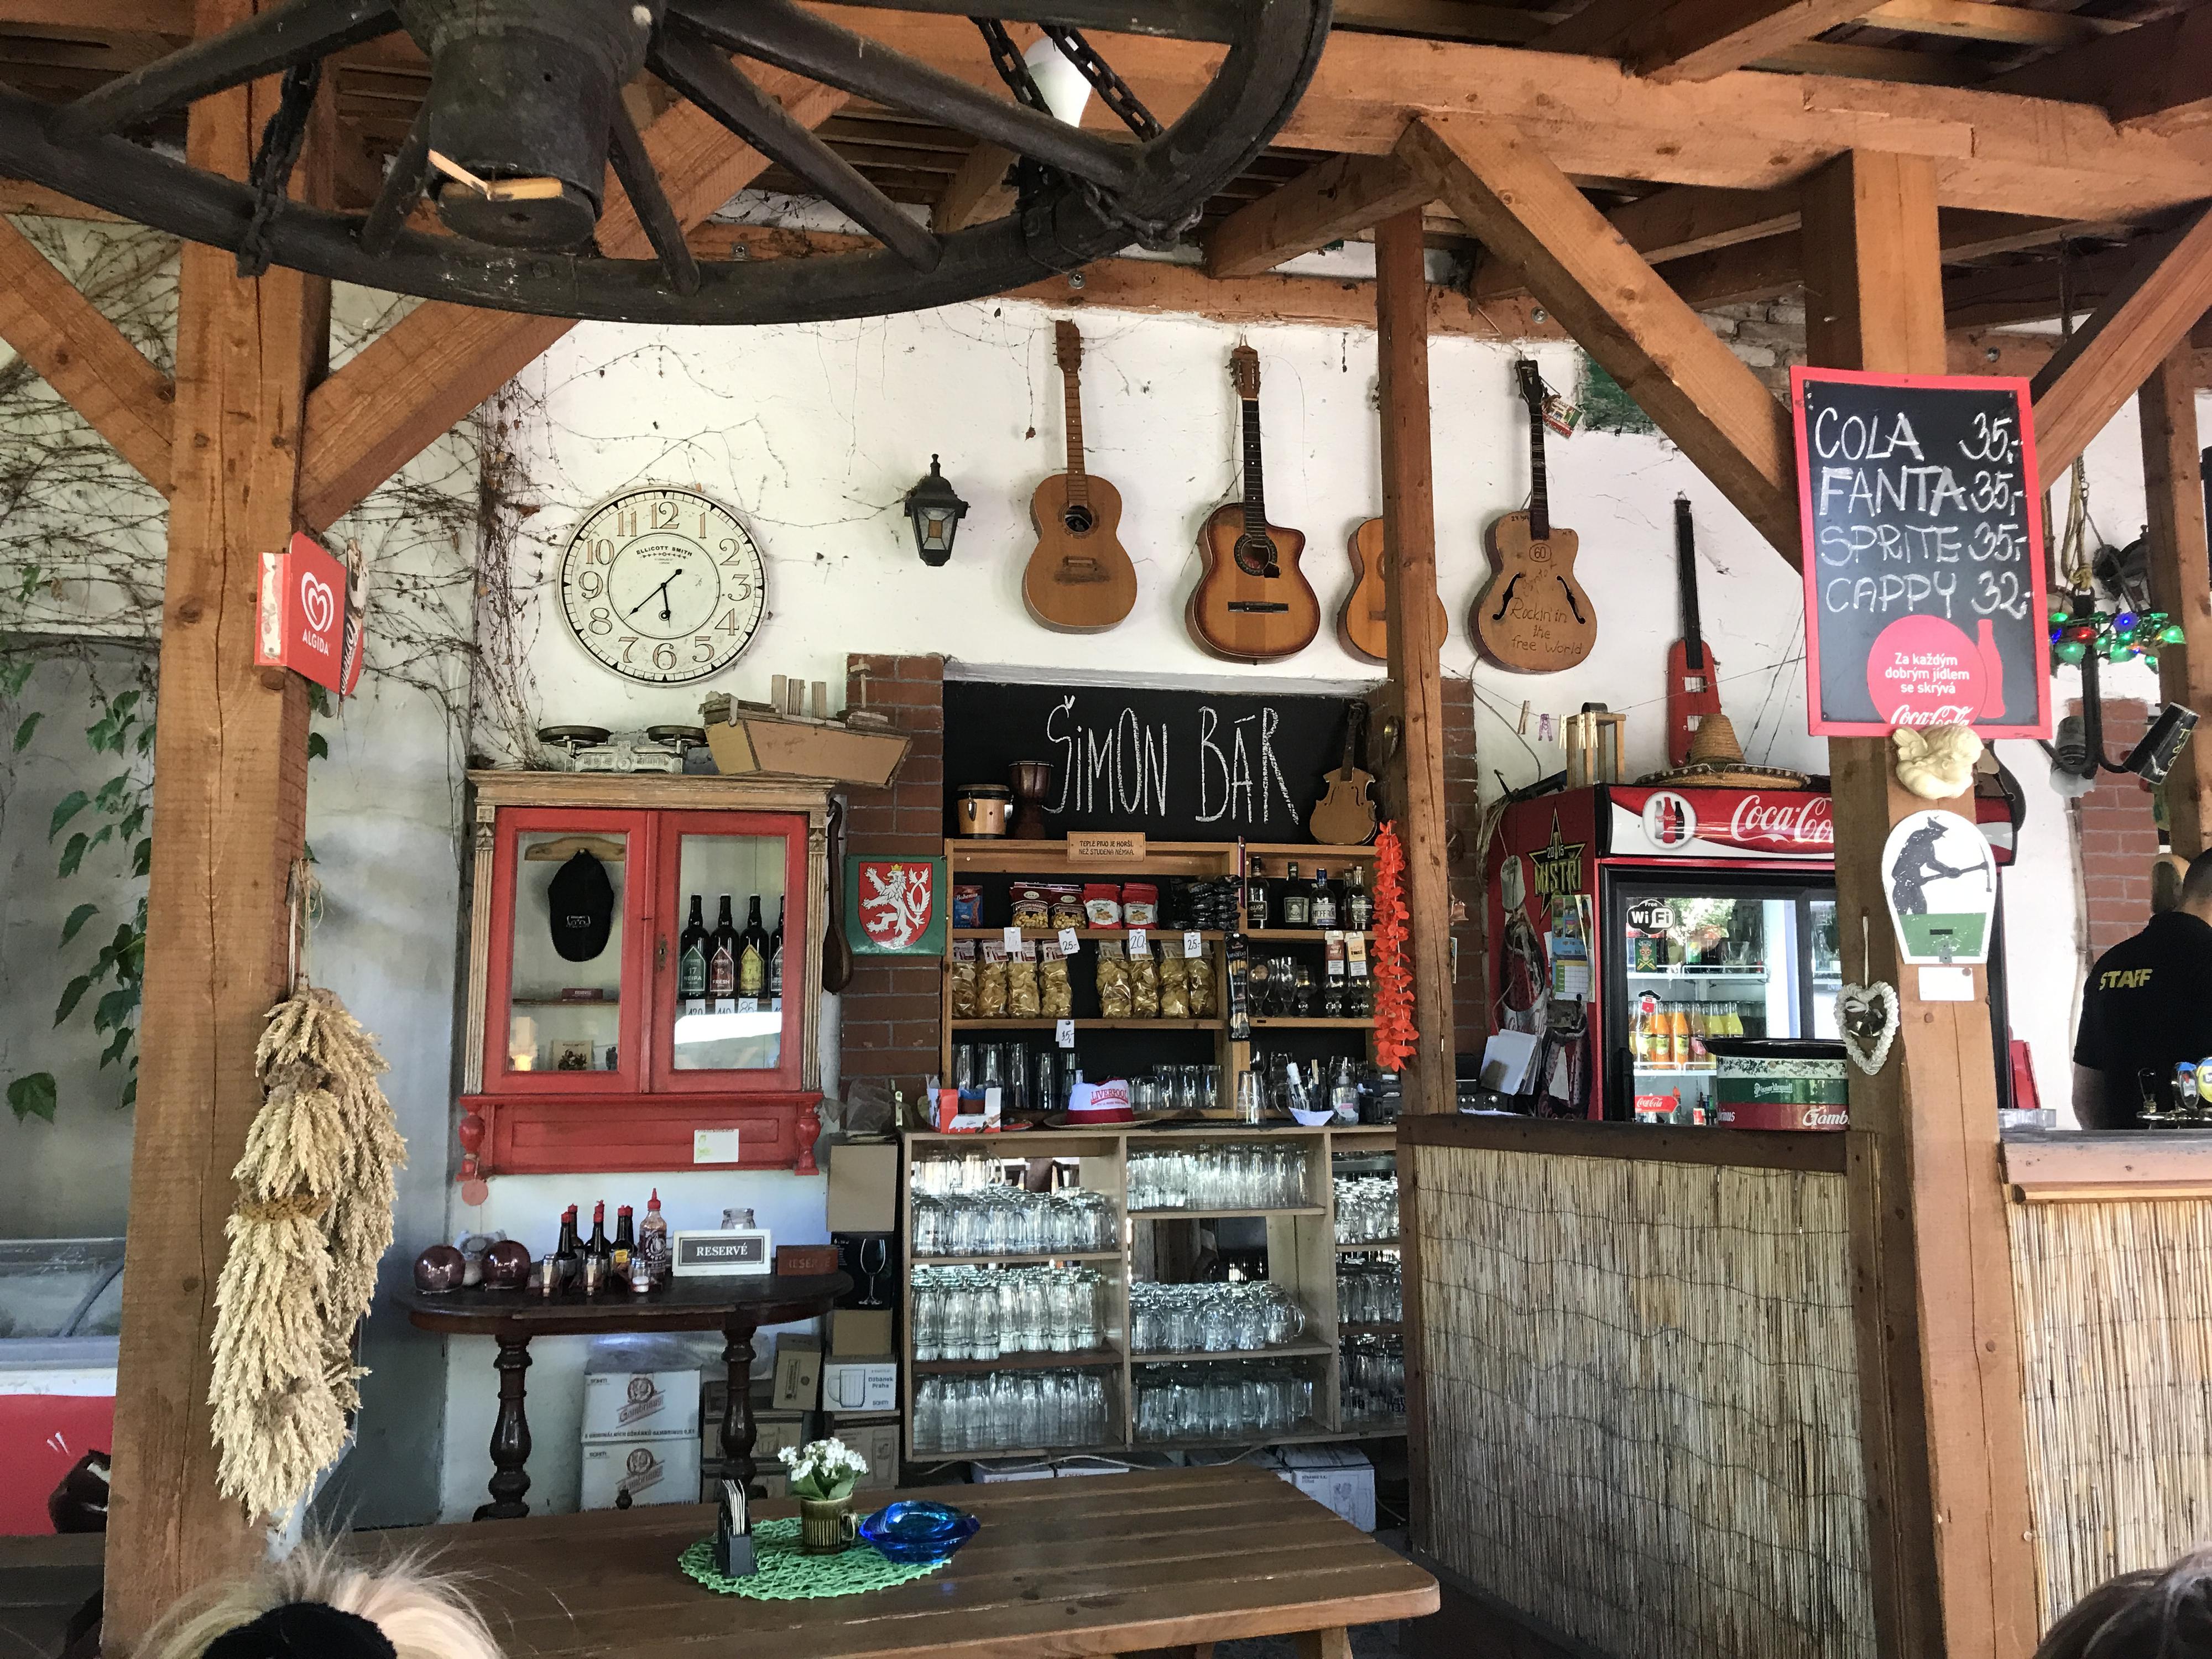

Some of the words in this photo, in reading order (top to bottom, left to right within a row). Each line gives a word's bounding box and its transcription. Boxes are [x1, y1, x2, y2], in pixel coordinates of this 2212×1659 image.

[1815, 407, 1924, 461] COLA
[1819, 465, 1968, 517] FANTA
[617, 510, 638, 537] 11
[650, 501, 680, 530] 12
[698, 512, 707, 539] 1
[585, 539, 615, 565] 10
[636, 546, 669, 555] ELLICOTT
[672, 547, 692, 556] SMITH
[719, 538, 740, 566] 2
[1534, 547, 1546, 559] 60
[1820, 524, 1962, 566] SPRITE
[578, 571, 604, 599] 9
[727, 574, 752, 602] 3
[1826, 570, 1957, 619] CAPPY
[588, 607, 613, 635] 8
[714, 608, 740, 637] 4
[1555, 608, 1567, 623] in
[301, 628, 330, 657] ALGIDA
[1511, 635, 1536, 651] free
[1533, 624, 1551, 639] the
[618, 637, 639, 664] 7
[652, 643, 677, 670] 6
[692, 635, 715, 662] 5
[1895, 652, 1910, 665] Za
[1912, 653, 1958, 669] každým
[1885, 666, 1929, 682] dobrým
[1932, 667, 1970, 682] jídlem
[1900, 684, 1914, 693] se
[1917, 681, 1956, 696] skrývá
[1194, 705, 1300, 826] BÁR
[1730, 794, 1834, 843] Coca-Co
[2099, 968, 2153, 991] STAFF
[1091, 1088, 1127, 1099] LIVERPOOL
[1771, 1082, 1793, 1094] Urquell
[1802, 1107, 1850, 1126] Gamb
[696, 1242, 748, 1257] RESERVÉ
